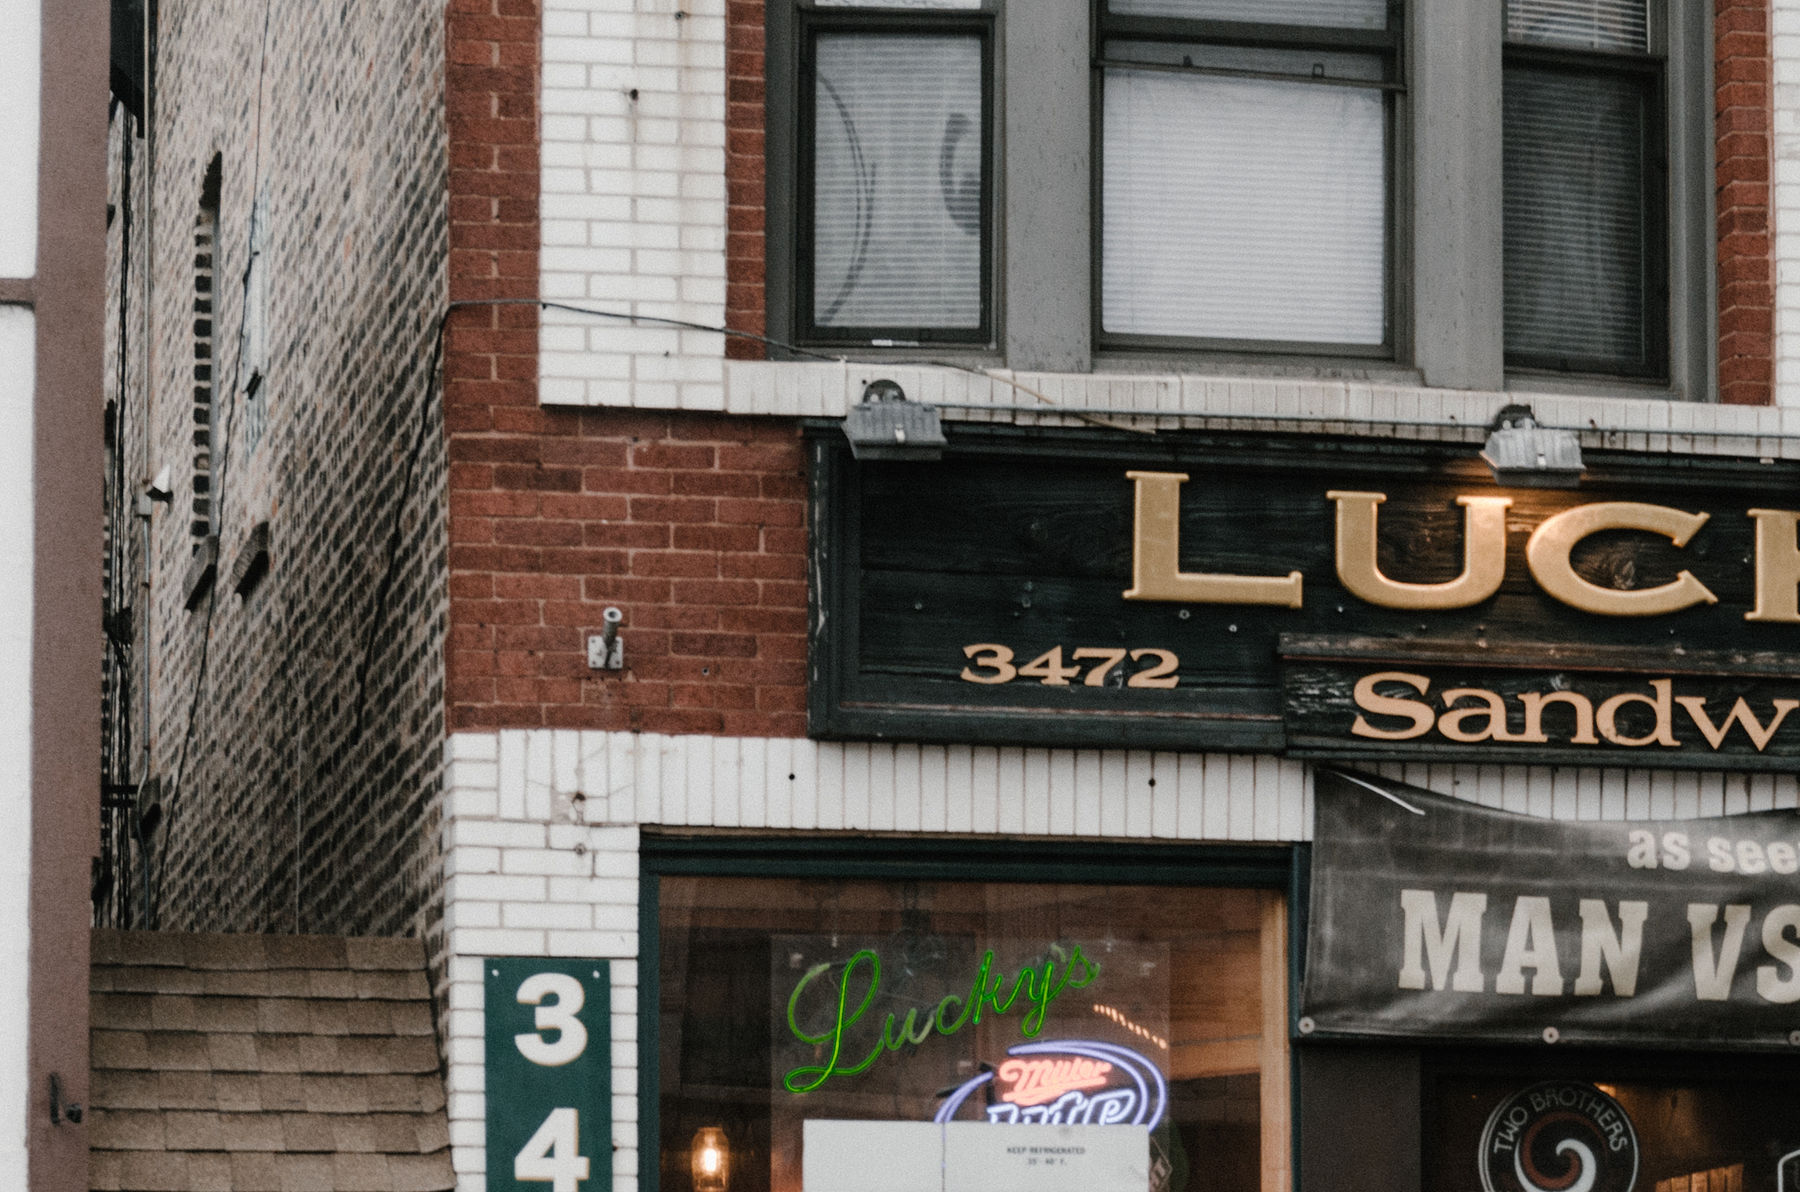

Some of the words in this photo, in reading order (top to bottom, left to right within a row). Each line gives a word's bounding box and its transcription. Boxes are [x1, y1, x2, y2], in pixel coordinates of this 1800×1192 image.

[960, 643, 1181, 690] 3472
[1627, 829, 1691, 871] as
[1398, 889, 1650, 997] MAN
[784, 943, 1101, 1093] Lucky's
[1493, 1106, 1528, 1154] TWO
[1533, 1086, 1628, 1152] BROTHERS
